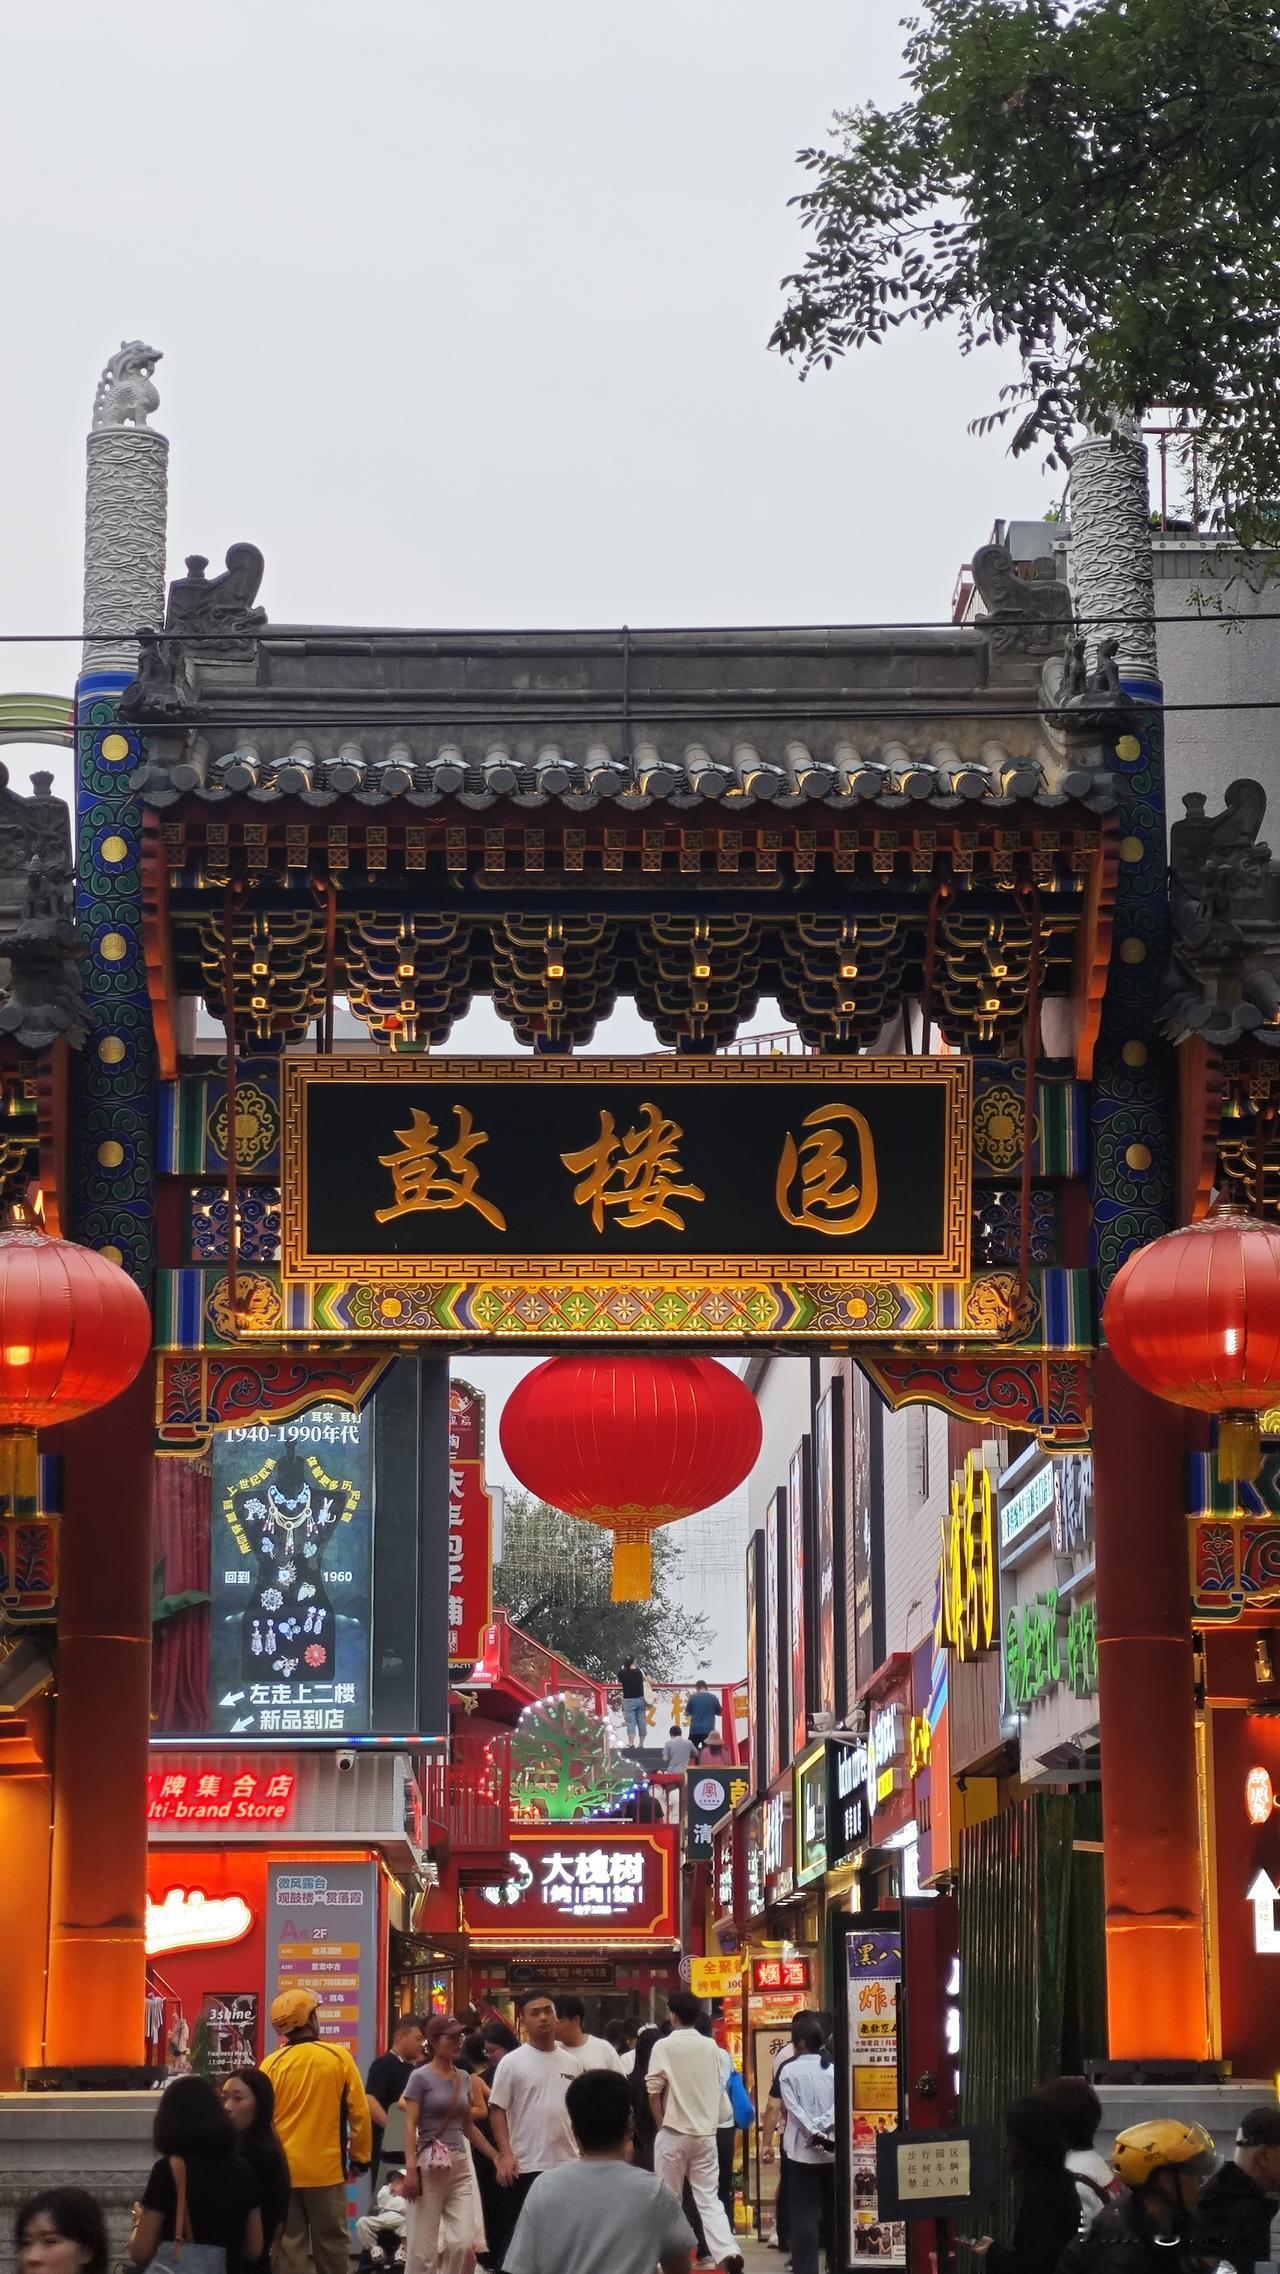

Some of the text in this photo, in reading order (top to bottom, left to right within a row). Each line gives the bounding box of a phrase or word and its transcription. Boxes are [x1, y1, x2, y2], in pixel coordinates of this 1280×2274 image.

[224, 1425, 360, 1444] 1940-1990年代
[224, 1571, 250, 1584] 回到
[323, 1571, 353, 1583] 1960
[250, 1683, 356, 1705] 左走上二楼
[260, 1708, 345, 1730] 新品到店
[147, 1774, 294, 1799] 牌集合店
[235, 1802, 286, 1818] Store
[541, 1849, 645, 1885] 大槐树
[278, 1876, 327, 1891] 微风露台
[313, 1929, 328, 1939] 2F
[209, 2008, 252, 2021] 3shine
[907, 2147, 960, 2161] 步行园区
[907, 2162, 960, 2175] 任何车辆
[907, 2176, 960, 2189] 禁止入内
